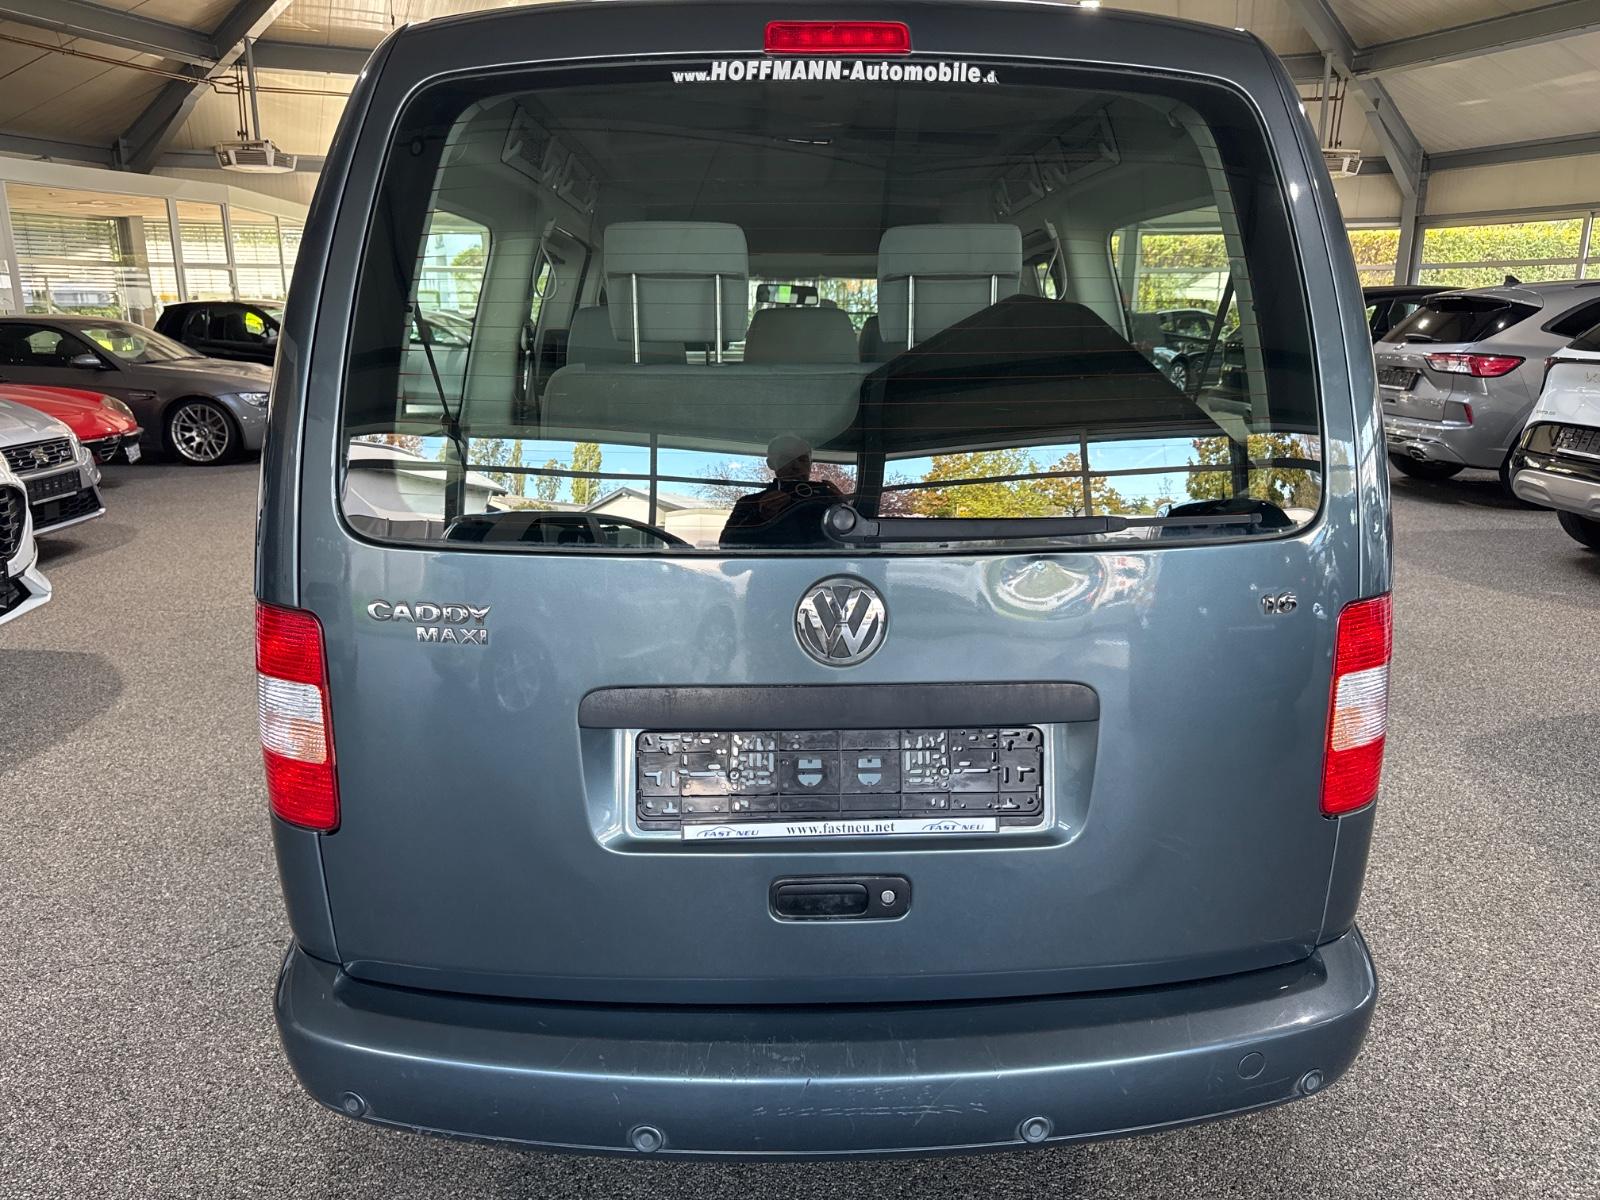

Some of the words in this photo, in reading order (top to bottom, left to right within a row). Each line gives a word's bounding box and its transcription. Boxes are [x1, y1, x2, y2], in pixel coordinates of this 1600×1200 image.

[366, 599, 491, 625] CADDY
[416, 626, 488, 645] MAXI
[786, 822, 896, 835] www.fastneu.net
[961, 823, 984, 831] NEU
[703, 830, 732, 838] FAST
